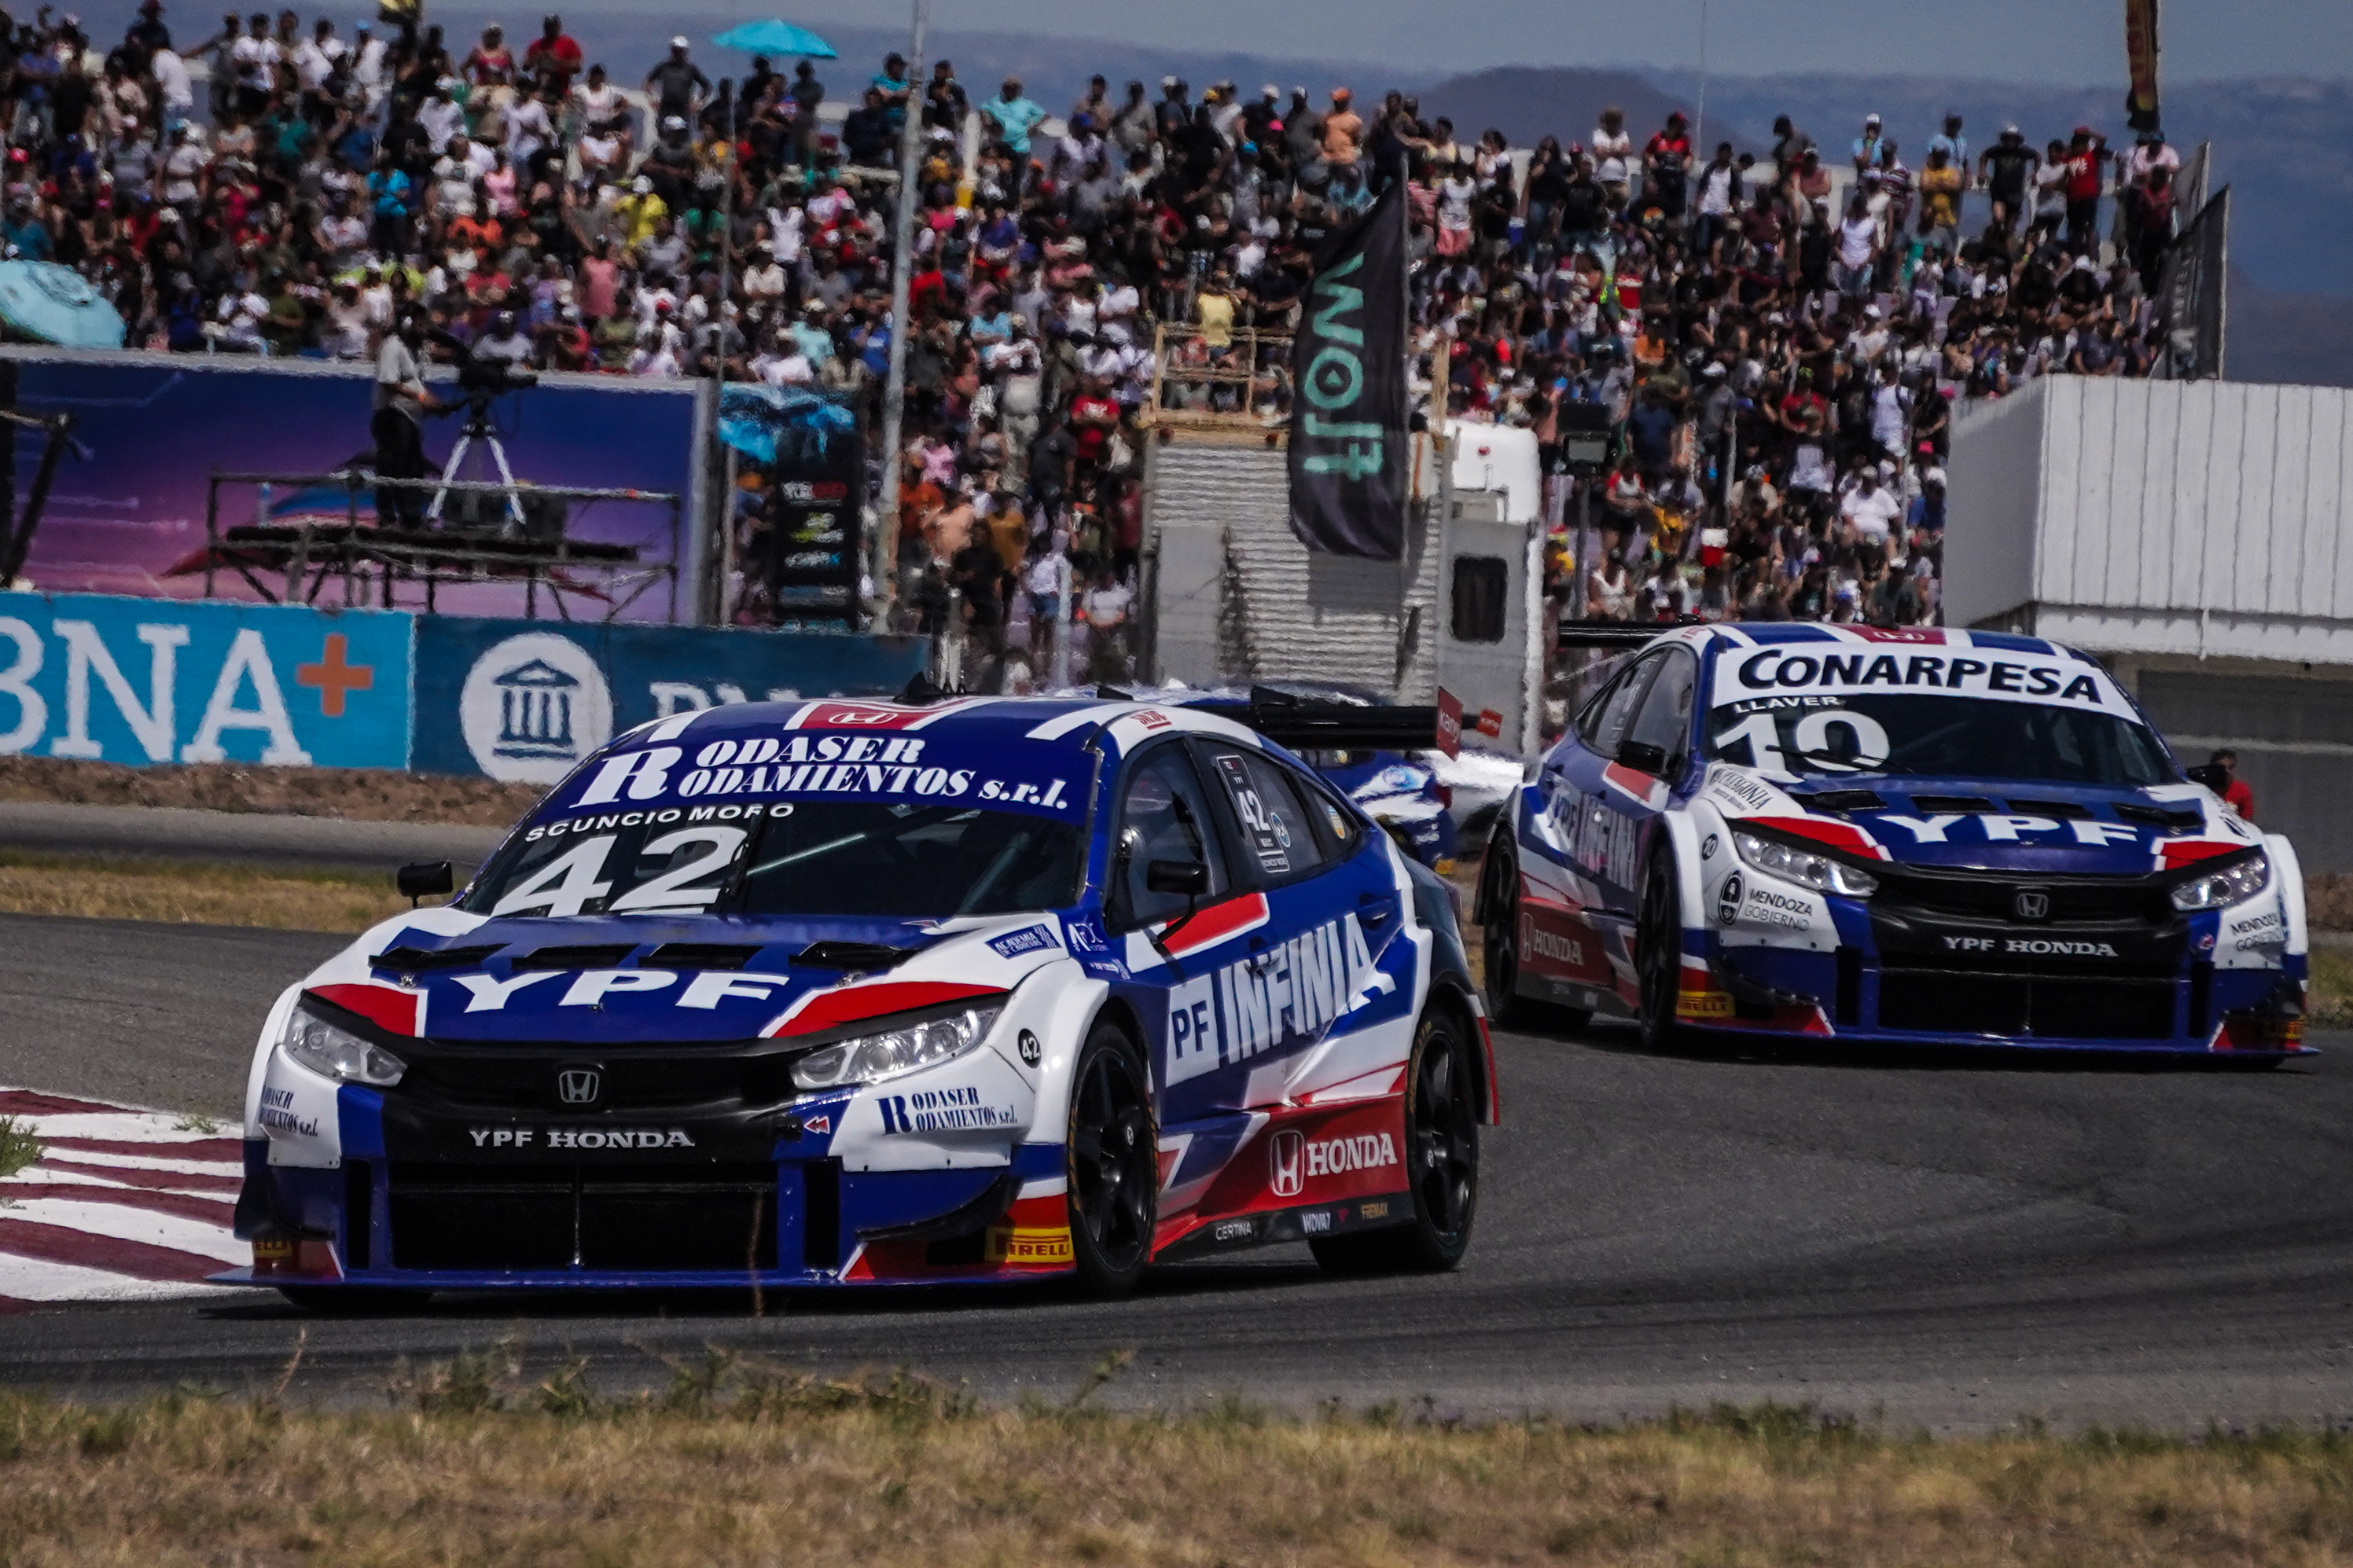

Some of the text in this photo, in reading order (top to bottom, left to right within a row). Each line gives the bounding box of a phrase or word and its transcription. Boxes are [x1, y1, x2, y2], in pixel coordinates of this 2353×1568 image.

[1738, 648, 2104, 705] CONARPESA
[1734, 696, 1840, 713] LLAVER
[1715, 710, 1891, 784] 10
[977, 777, 1068, 810] s.r.l.
[525, 808, 681, 843] SCUNCIO
[1237, 789, 1271, 832] 42
[1876, 814, 2138, 846] YPF
[489, 826, 748, 916] 42
[1744, 904, 1810, 931] GOBIERNO
[1749, 888, 1813, 917] MENDOZA
[1533, 928, 1586, 967] HONDA
[1943, 935, 2119, 957] YPF HONDA
[450, 970, 790, 1014] YPF
[1021, 1037, 1041, 1060] 42
[998, 1104, 1018, 1126] s.r.l.
[469, 1129, 696, 1148] YPF HONDA
[1307, 1132, 1398, 1177] HONDA
[1215, 1221, 1253, 1241] CERTINA
